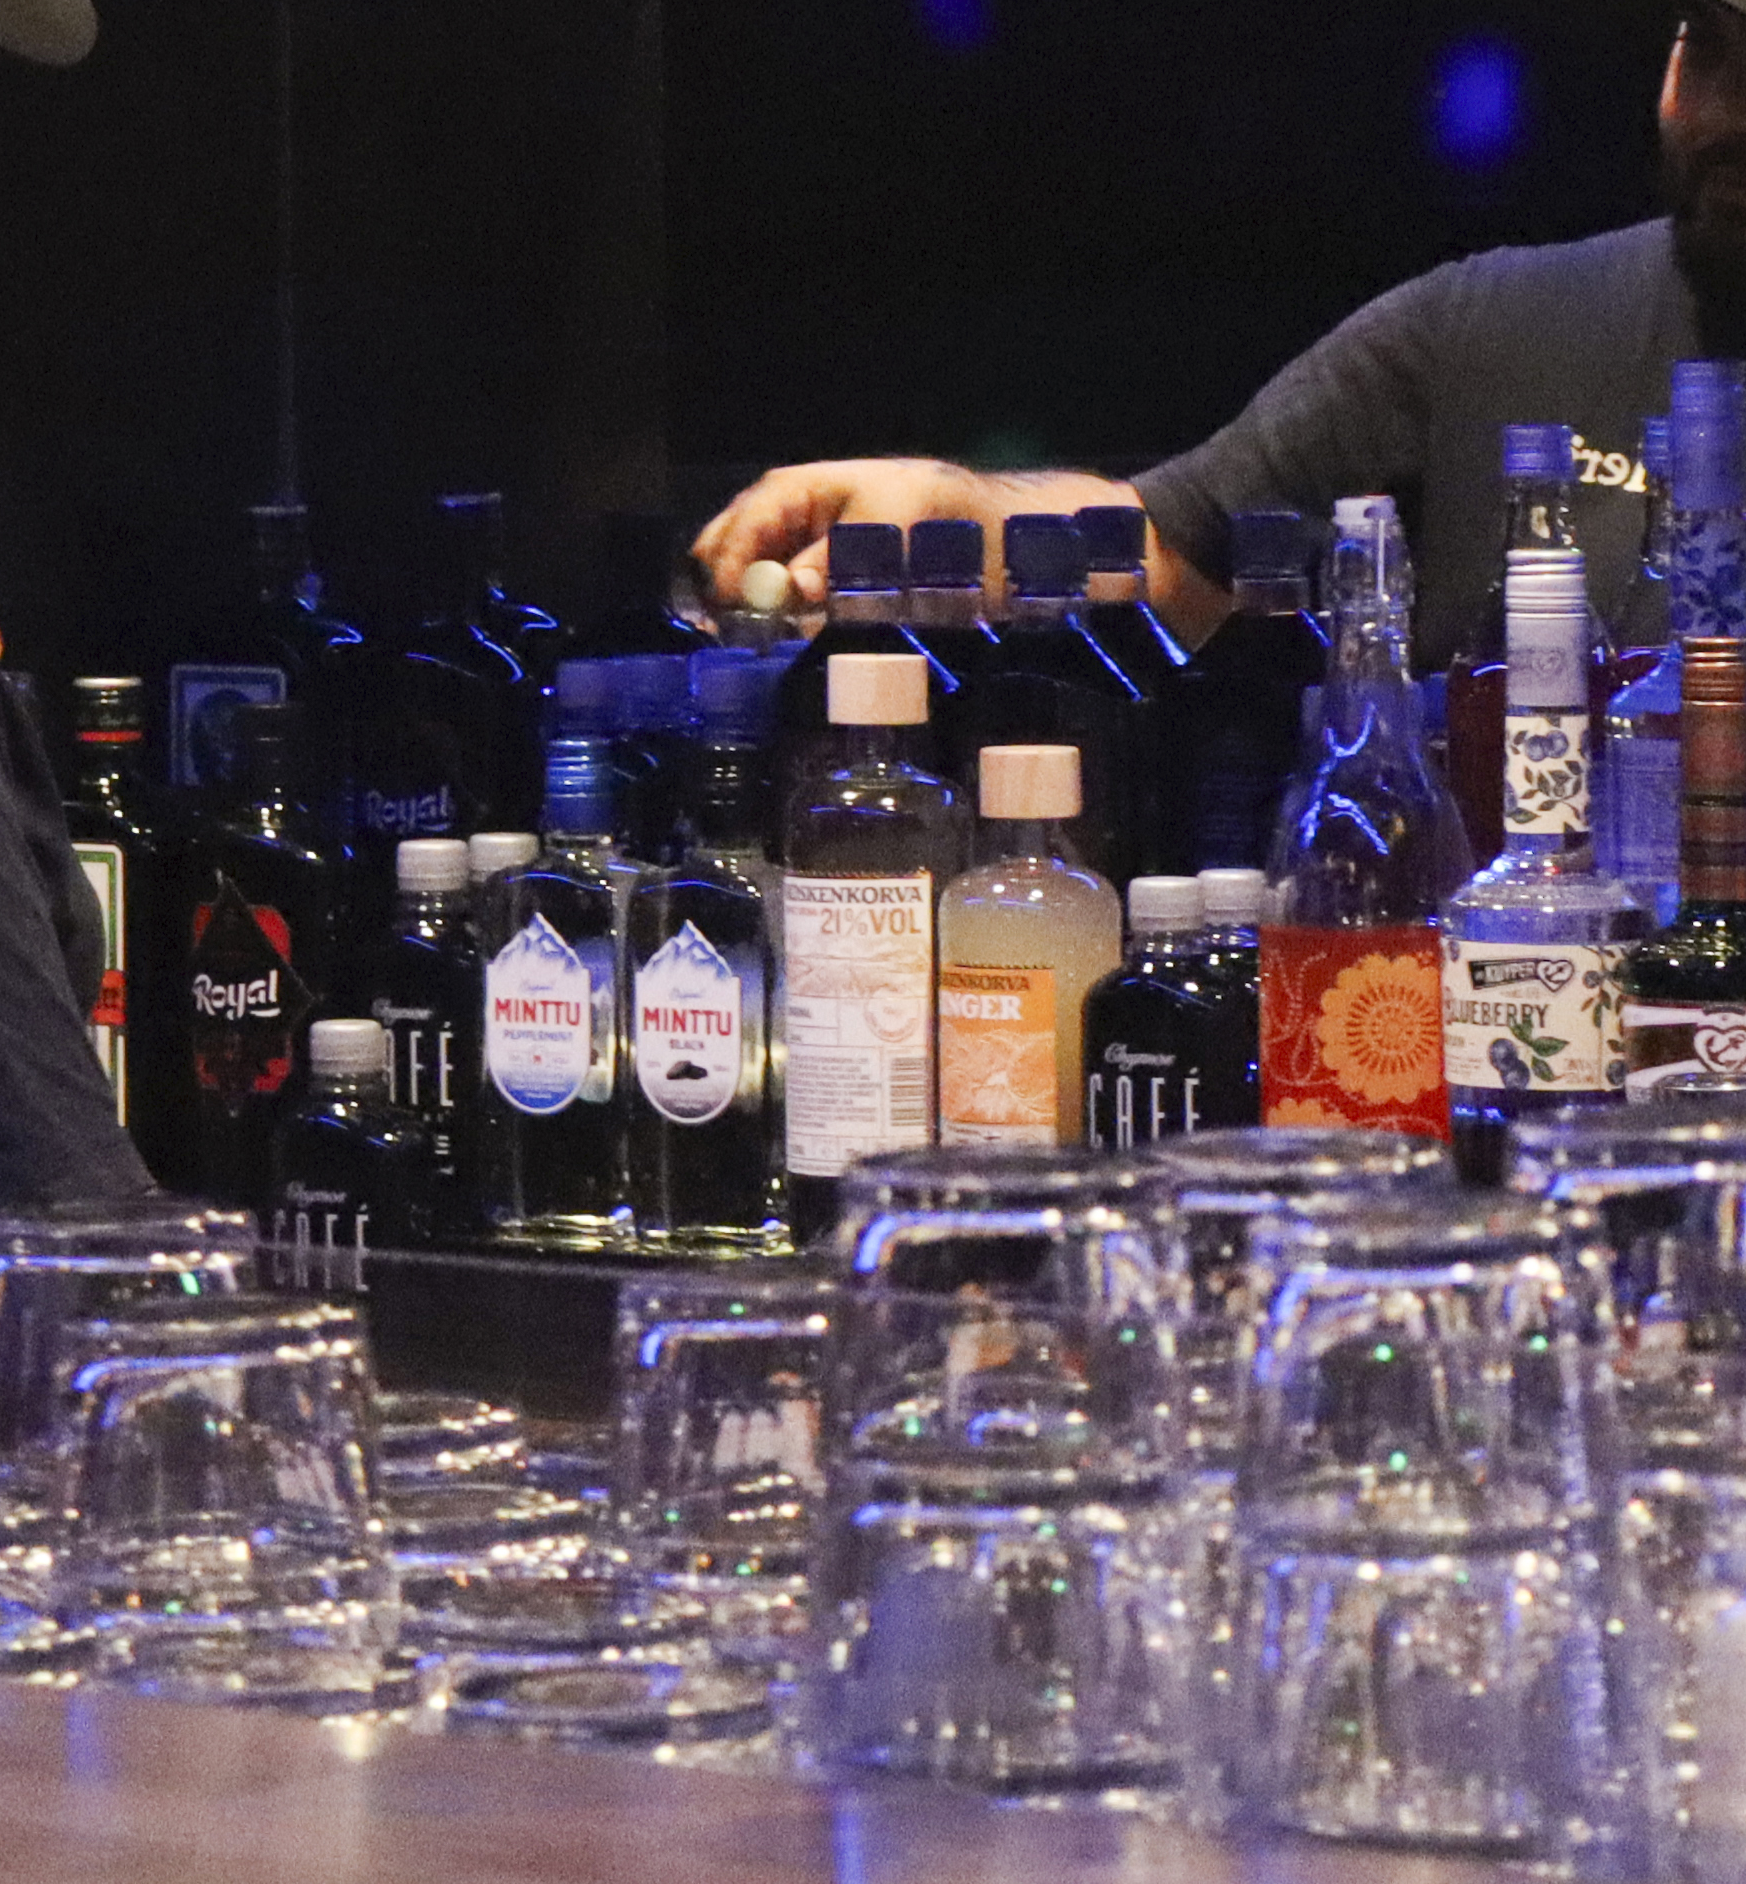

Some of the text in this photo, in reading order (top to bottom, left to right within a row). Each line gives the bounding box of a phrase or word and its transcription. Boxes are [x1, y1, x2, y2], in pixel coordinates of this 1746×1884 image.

[191, 967, 282, 1021] Royal
[494, 997, 581, 1027] MINTTU
[642, 1005, 733, 1037] MINTTU
[502, 1027, 574, 1044] PEPPERMINT
[669, 1038, 707, 1053] BLACK
[1088, 1066, 1202, 1152] CAFÉ
